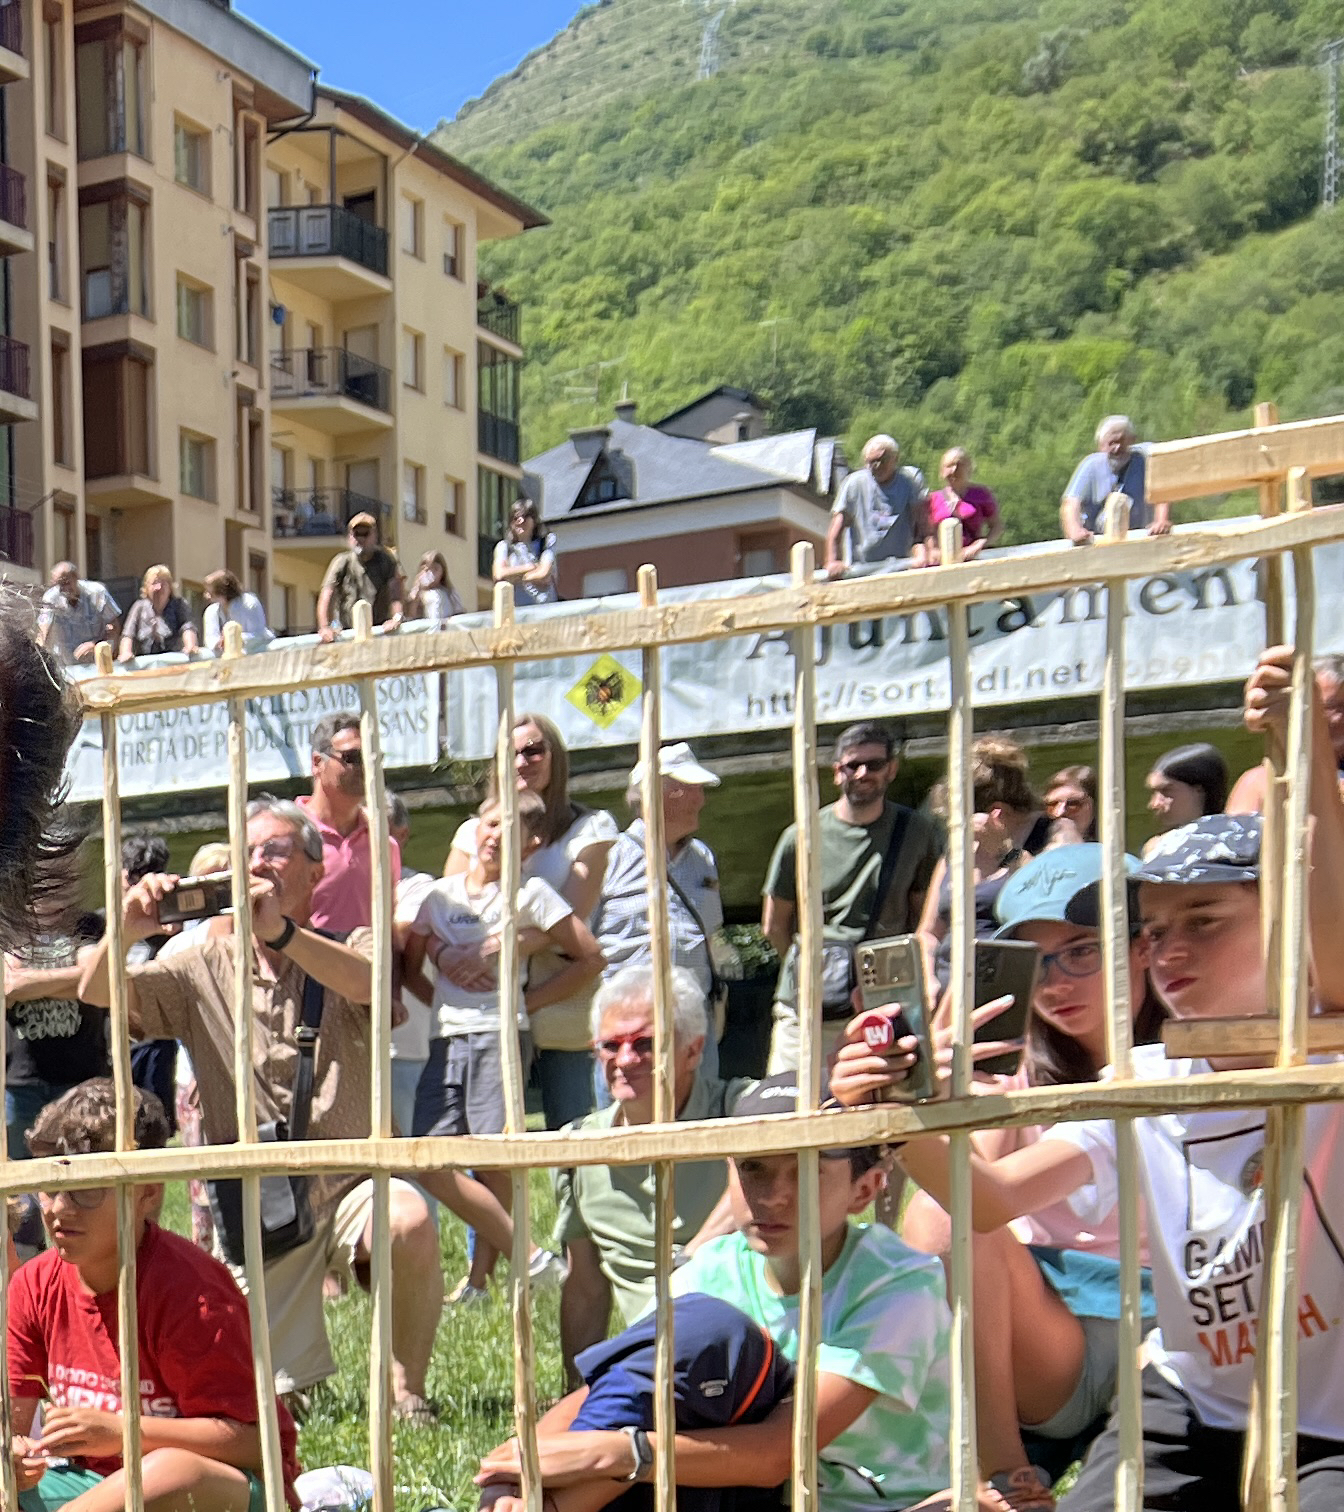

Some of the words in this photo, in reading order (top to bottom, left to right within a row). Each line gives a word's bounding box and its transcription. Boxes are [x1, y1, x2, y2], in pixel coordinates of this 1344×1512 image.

[119, 706, 191, 734] OLLADA
[378, 676, 428, 705] SORA
[121, 735, 178, 767] FIRETA
[184, 731, 209, 760] DE
[379, 707, 429, 738] SANS
[1184, 1219, 1266, 1281] GAM
[1188, 1273, 1256, 1327] SET
